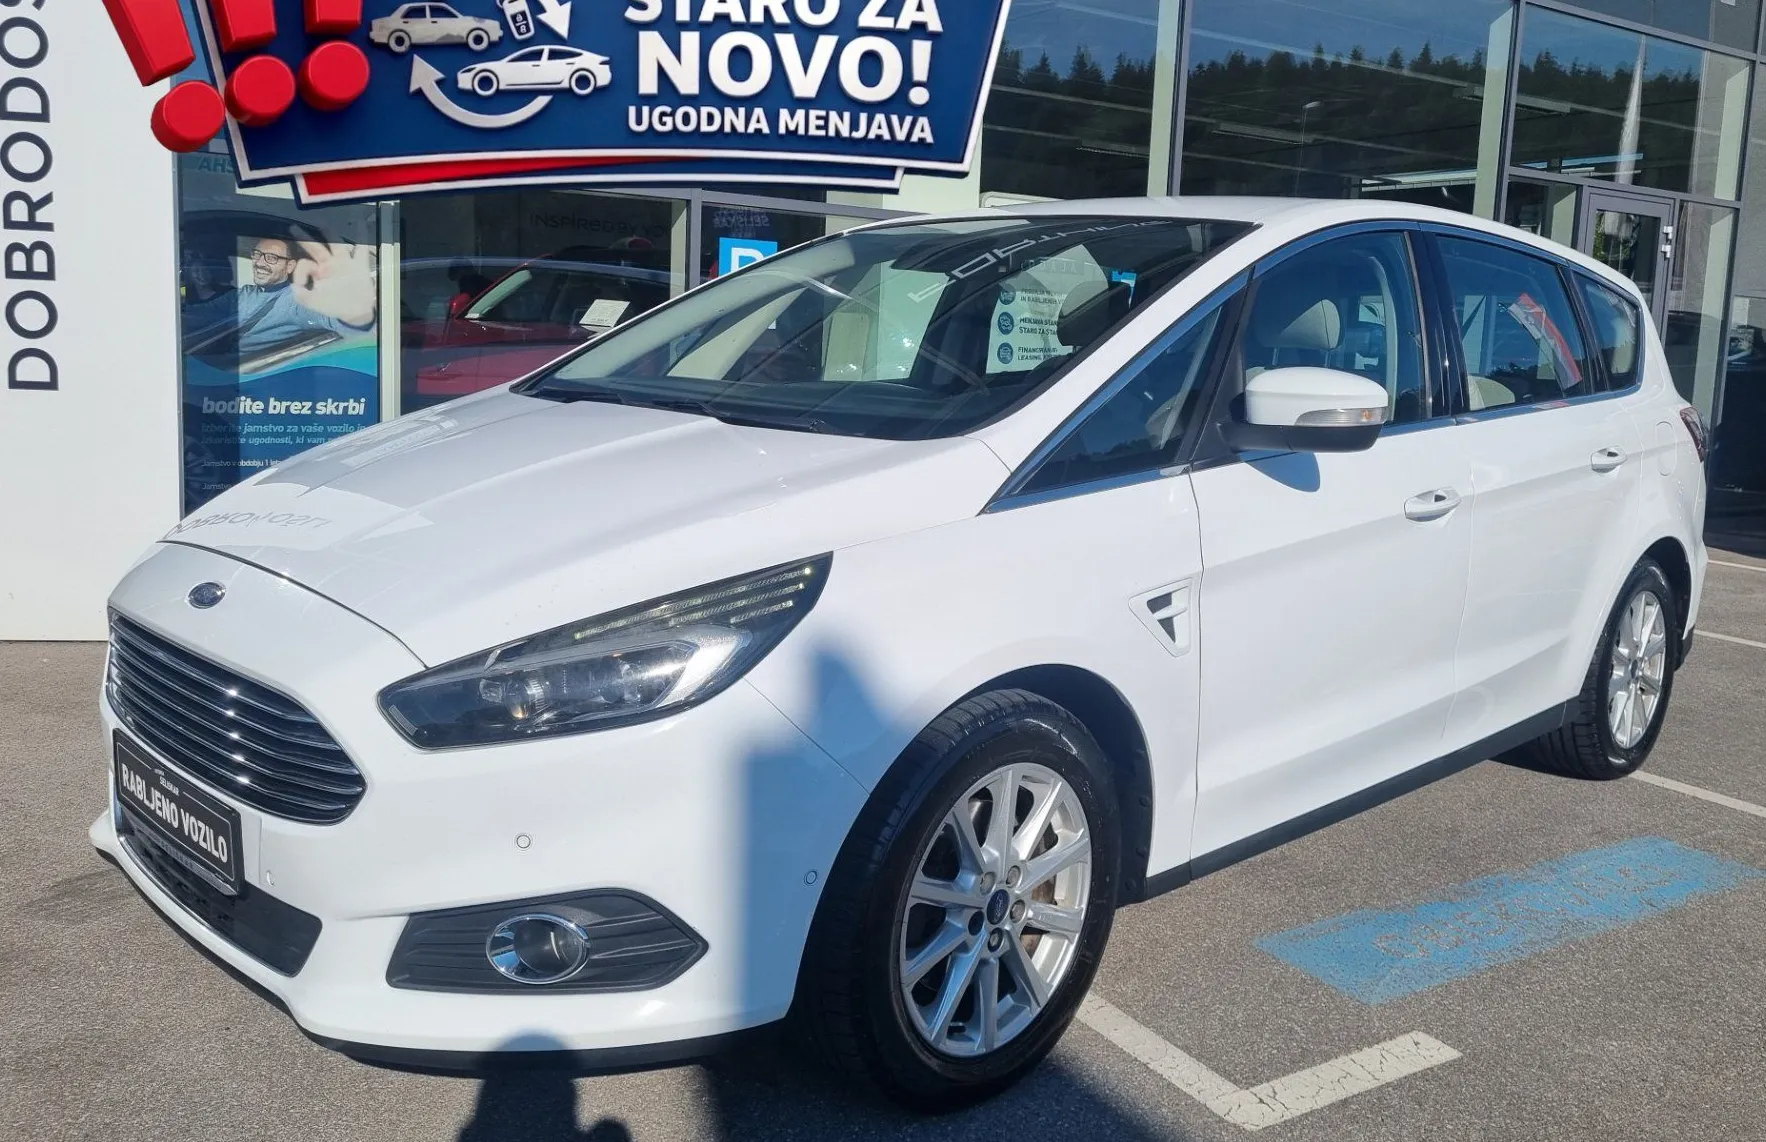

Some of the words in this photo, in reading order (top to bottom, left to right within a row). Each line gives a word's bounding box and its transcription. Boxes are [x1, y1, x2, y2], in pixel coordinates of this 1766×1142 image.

[0, 0, 59, 391] DOBRODO
[202, 396, 265, 415] bodite
[268, 397, 312, 415] brez
[315, 398, 366, 416] skrbi
[243, 423, 284, 436] jamstvo
[286, 424, 299, 433] za
[300, 423, 324, 433] vaše
[326, 422, 354, 433] vozilo
[248, 435, 293, 446] ugodnosti,
[121, 763, 179, 829] RABLJENO
[180, 808, 228, 863] VOZILO
